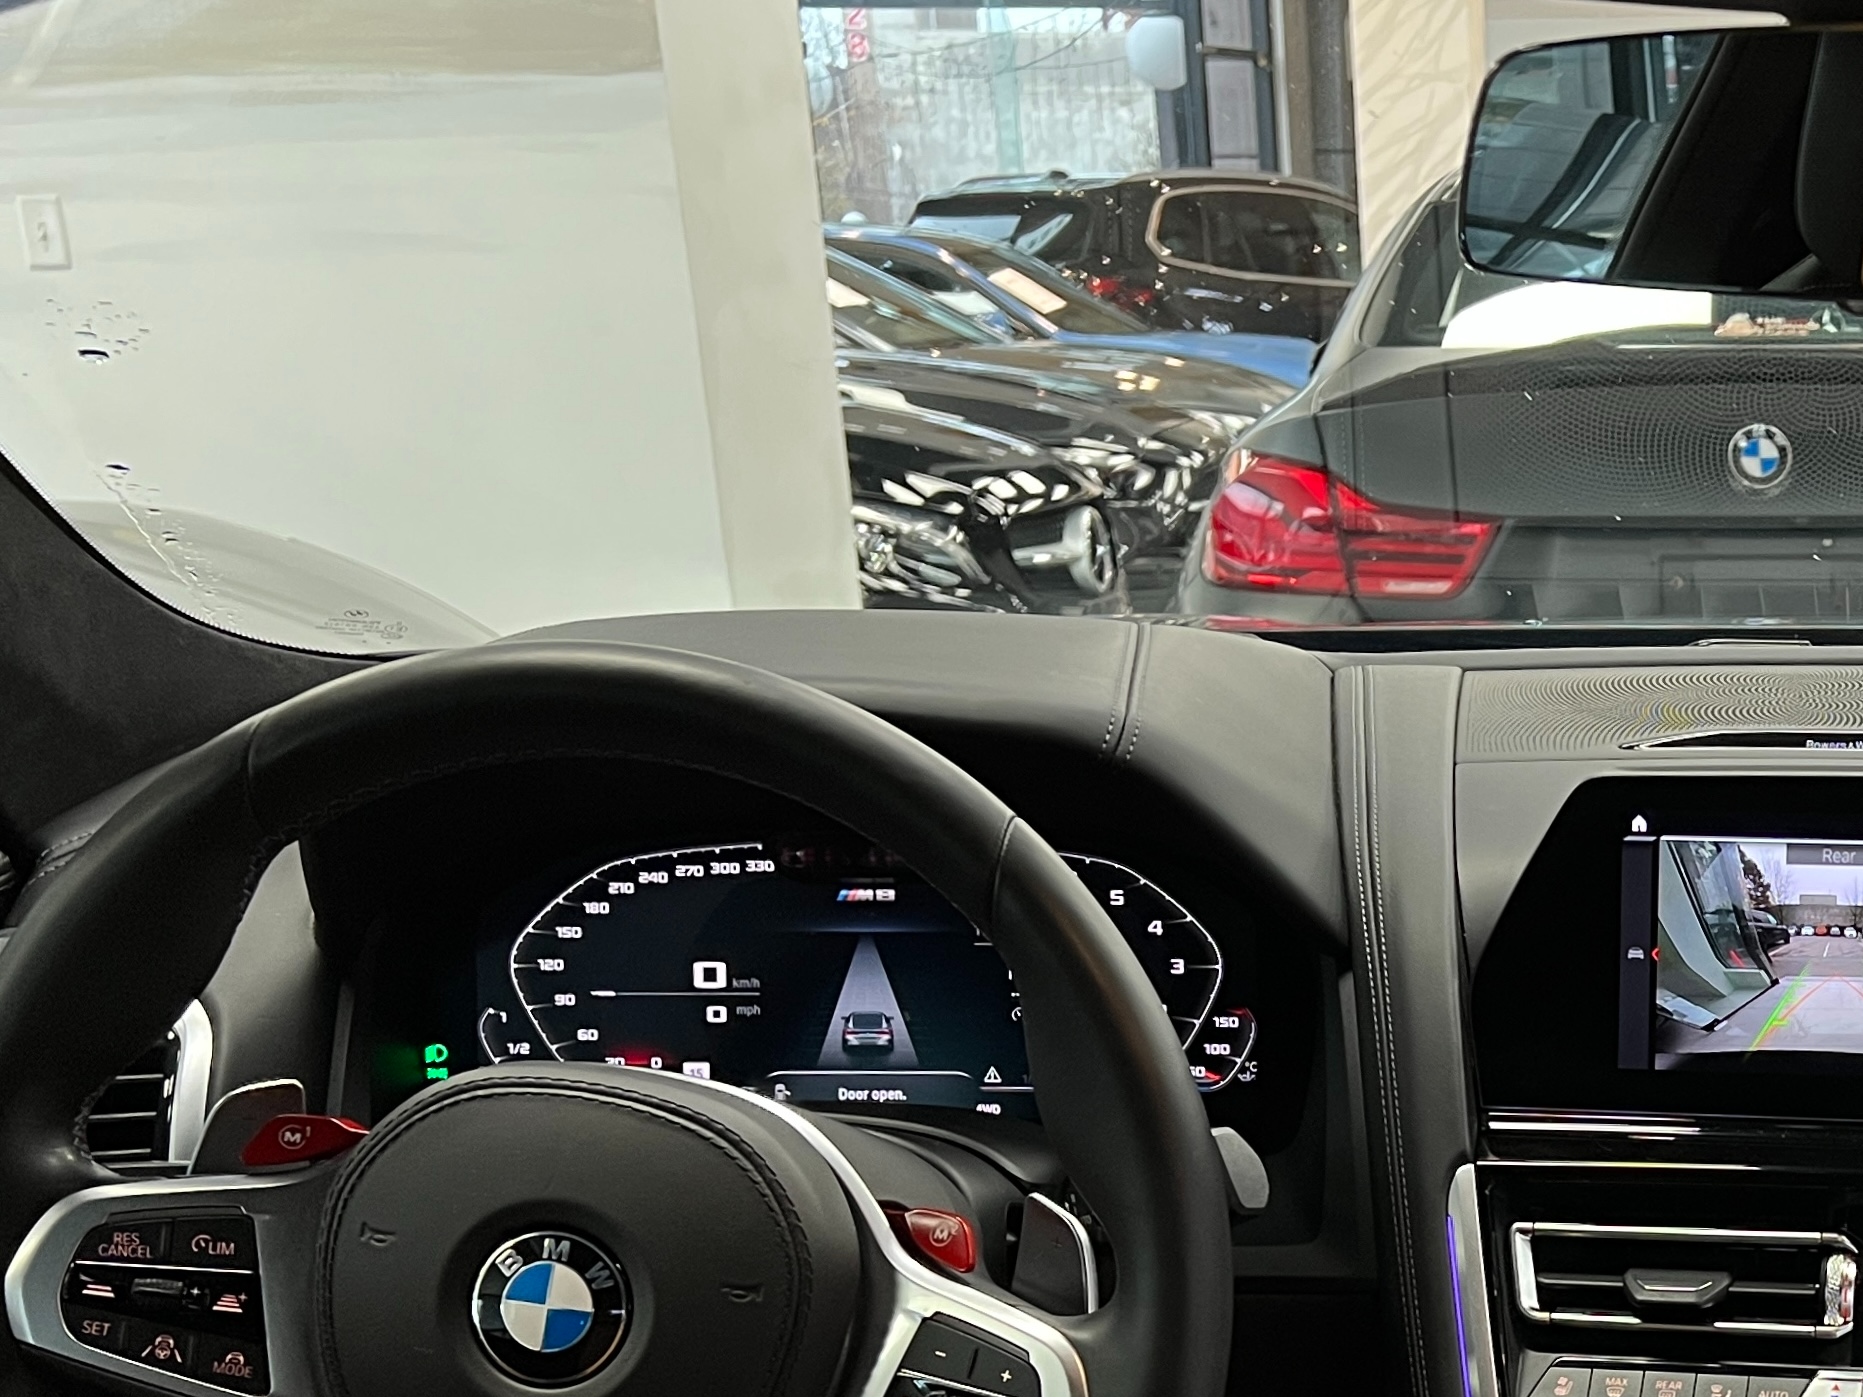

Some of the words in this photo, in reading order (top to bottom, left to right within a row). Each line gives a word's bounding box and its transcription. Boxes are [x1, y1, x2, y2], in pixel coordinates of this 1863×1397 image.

[1822, 848, 1856, 863] Rear
[675, 865, 704, 877] 270
[710, 862, 740, 875] 300
[745, 860, 775, 872] 330
[638, 872, 668, 884] 240
[608, 882, 635, 894] 210
[1110, 889, 1125, 905] 5
[583, 902, 610, 914] 180
[556, 926, 583, 938] 150
[1147, 920, 1163, 935] 4
[537, 959, 564, 971] 120
[1170, 958, 1185, 974] 3
[693, 961, 727, 989] 0
[732, 978, 760, 988] km/h
[554, 994, 576, 1005] 90
[706, 1005, 727, 1023] 0
[736, 1005, 761, 1016] mph
[1213, 1017, 1239, 1027] 150
[577, 1029, 599, 1040] 60
[507, 1042, 530, 1055] 1/2
[1204, 1044, 1230, 1055] 100
[650, 1057, 662, 1068] 0
[838, 1087, 869, 1101] Door
[871, 1089, 907, 1104] open.
[976, 1103, 1001, 1115] 4WD
[113, 1232, 140, 1246] RES
[98, 1244, 154, 1259] CANCEL
[208, 1242, 235, 1256] LIM
[495, 1237, 614, 1291] BMW
[82, 1320, 111, 1337] SET
[212, 1361, 253, 1379] MODE
[1605, 1377, 1629, 1387] MAX
[1655, 1380, 1683, 1390] REAR
